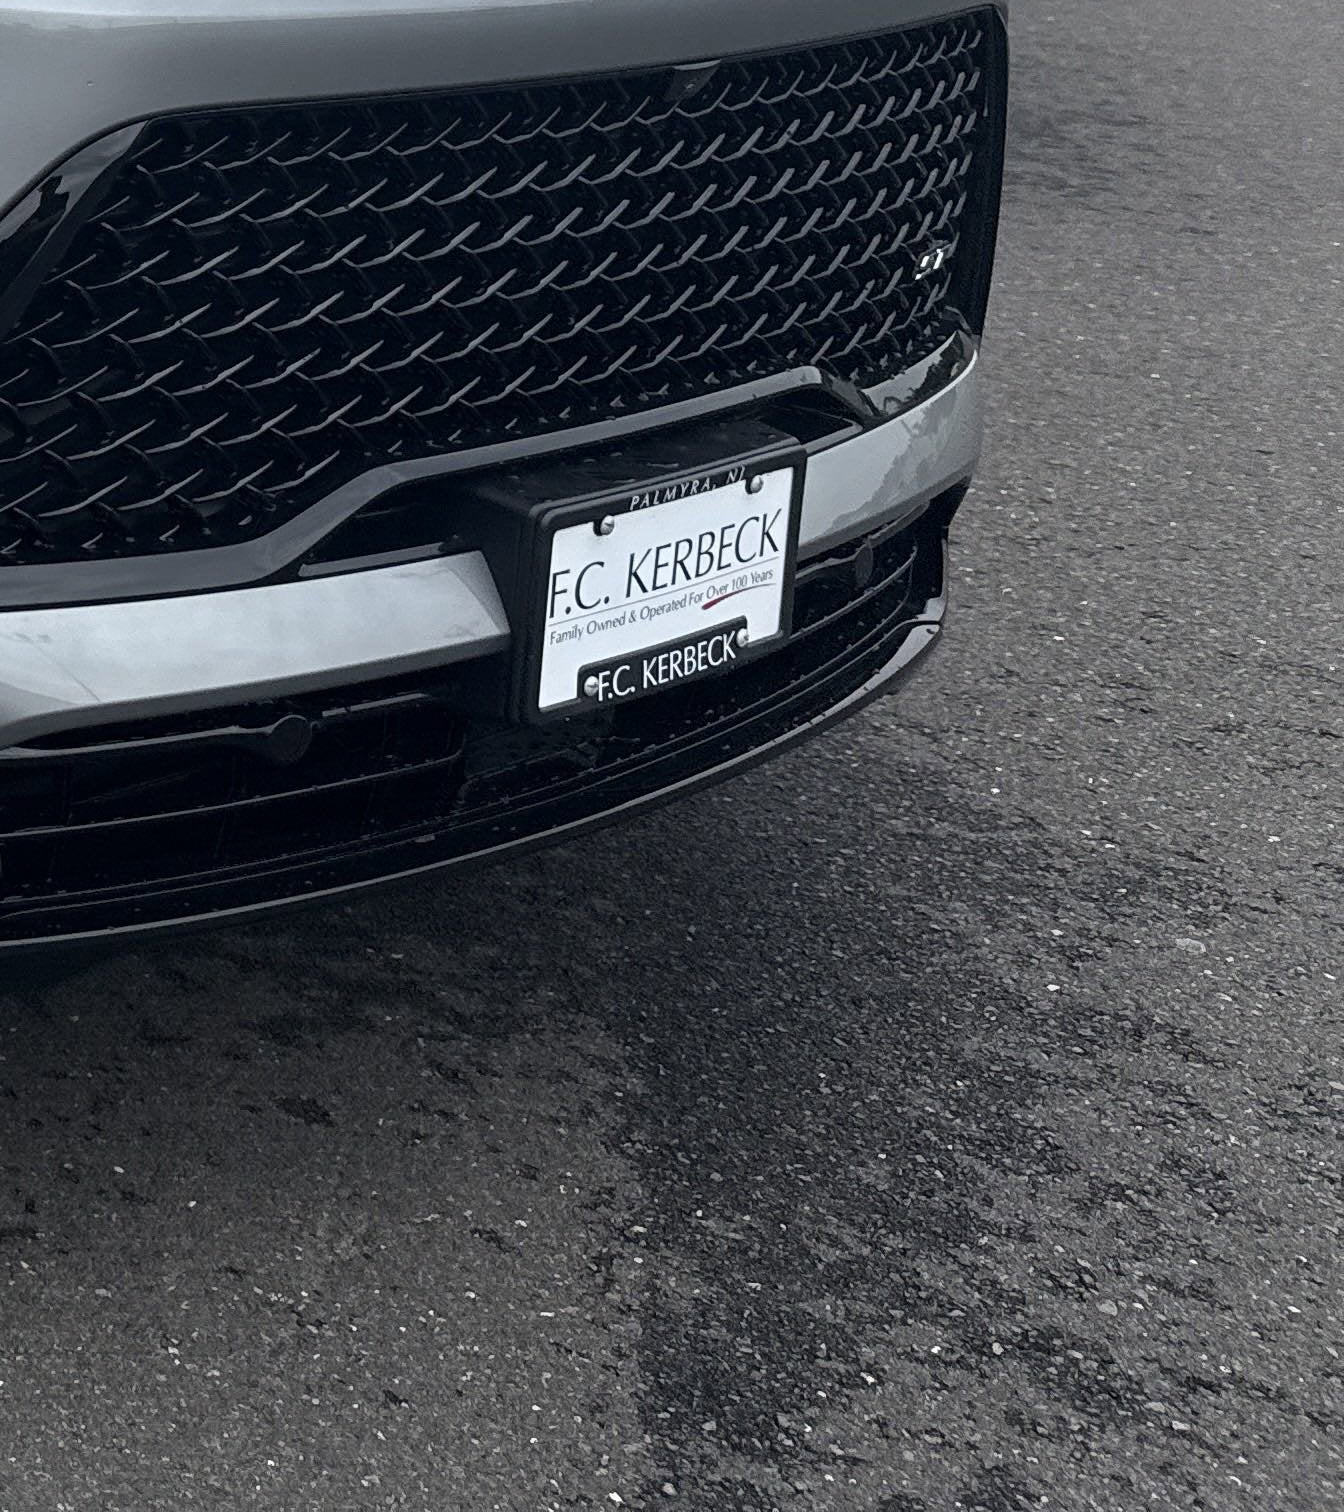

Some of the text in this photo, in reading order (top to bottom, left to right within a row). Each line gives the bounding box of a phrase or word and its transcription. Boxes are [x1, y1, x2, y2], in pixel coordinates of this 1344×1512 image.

[549, 508, 782, 619] F.C. KERBECK
[550, 569, 774, 646] Family Owned & Operated For Over 100 Years
[598, 630, 736, 702] F.C. KERBECK
